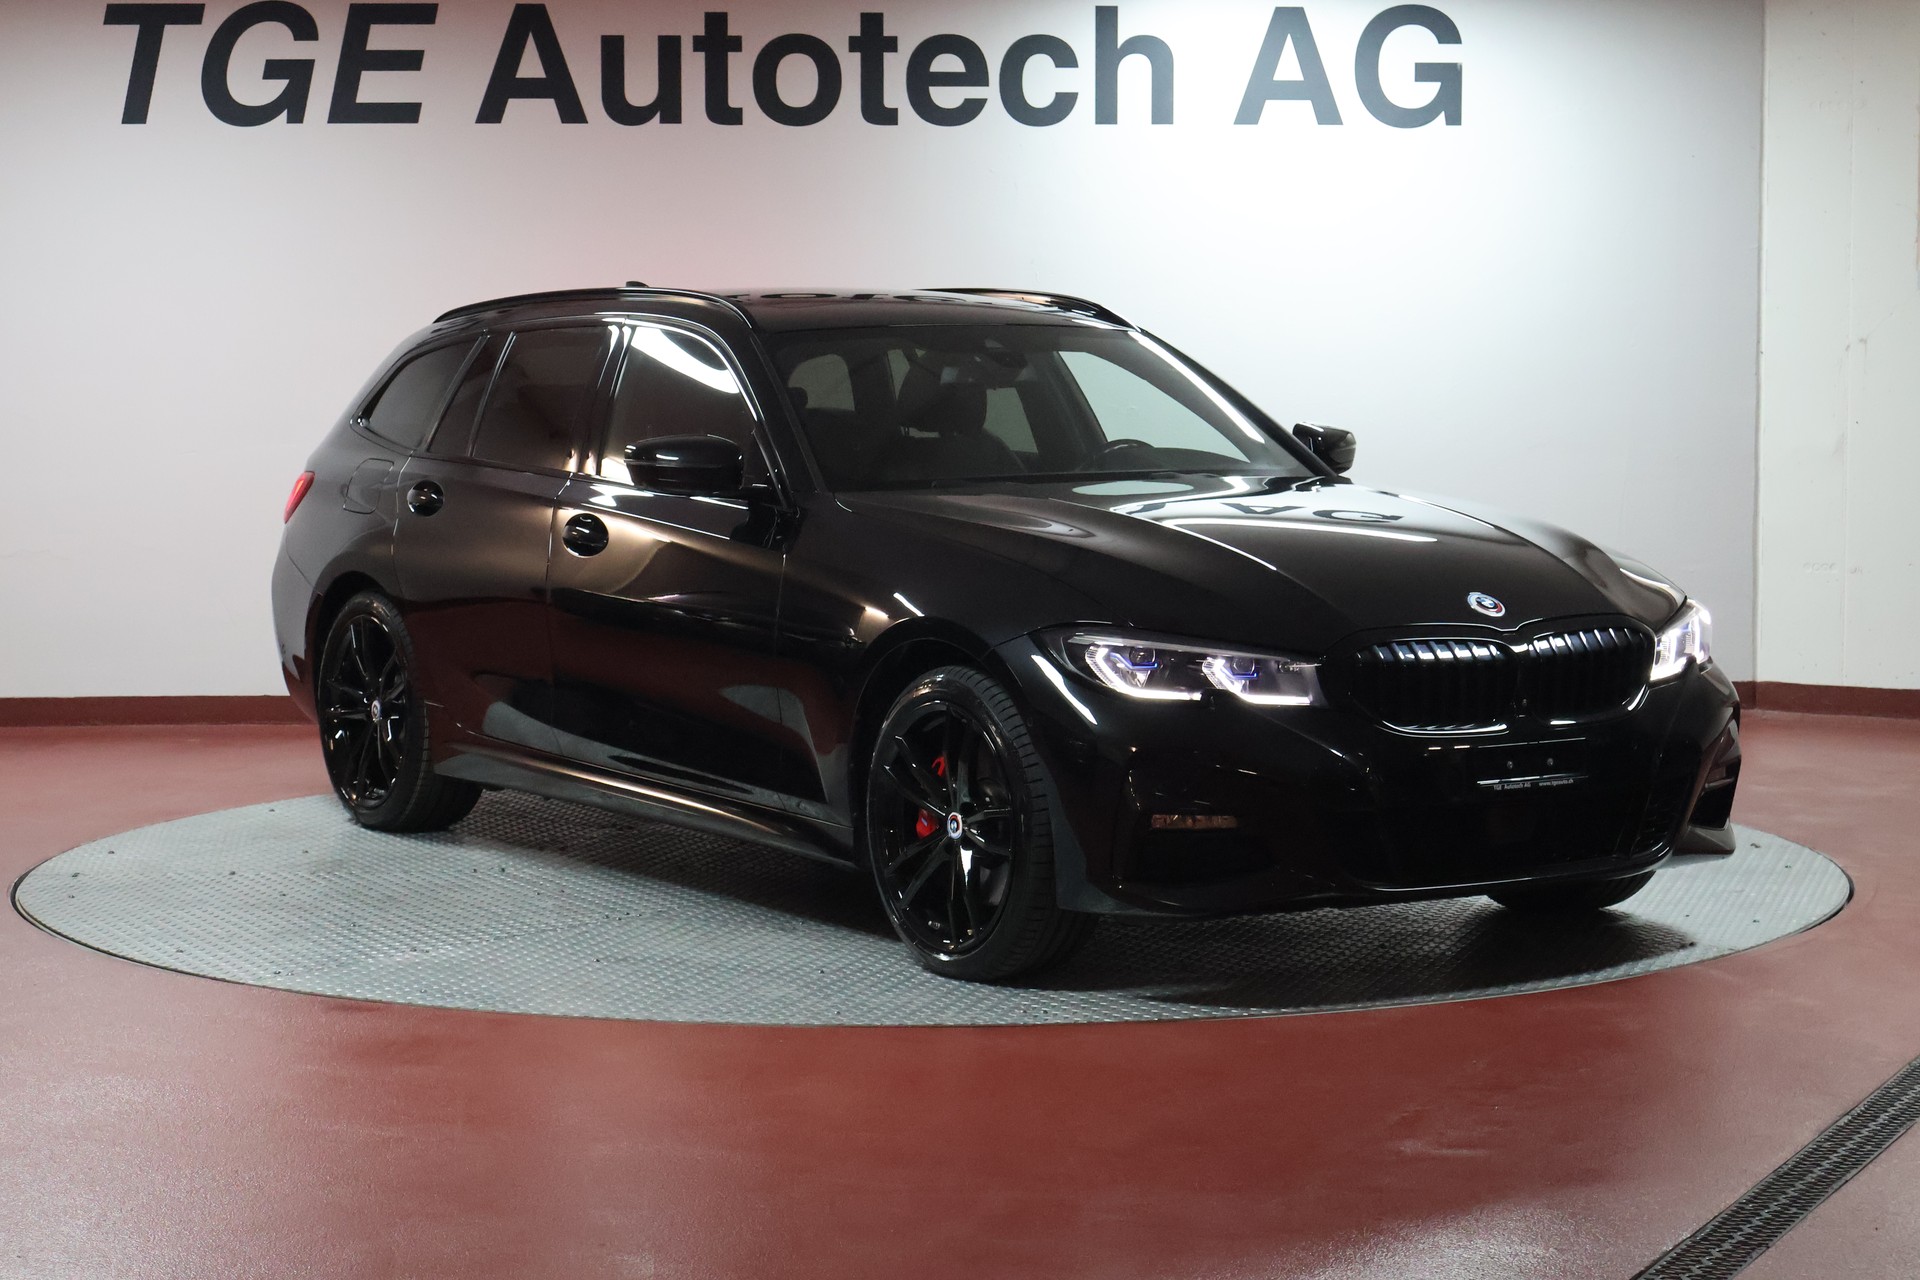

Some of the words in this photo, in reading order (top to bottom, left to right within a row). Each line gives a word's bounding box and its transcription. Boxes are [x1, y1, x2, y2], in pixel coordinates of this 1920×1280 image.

[103, 0, 439, 127] TGE
[475, 3, 1173, 126] Autotech
[1234, 4, 1463, 127] AG
